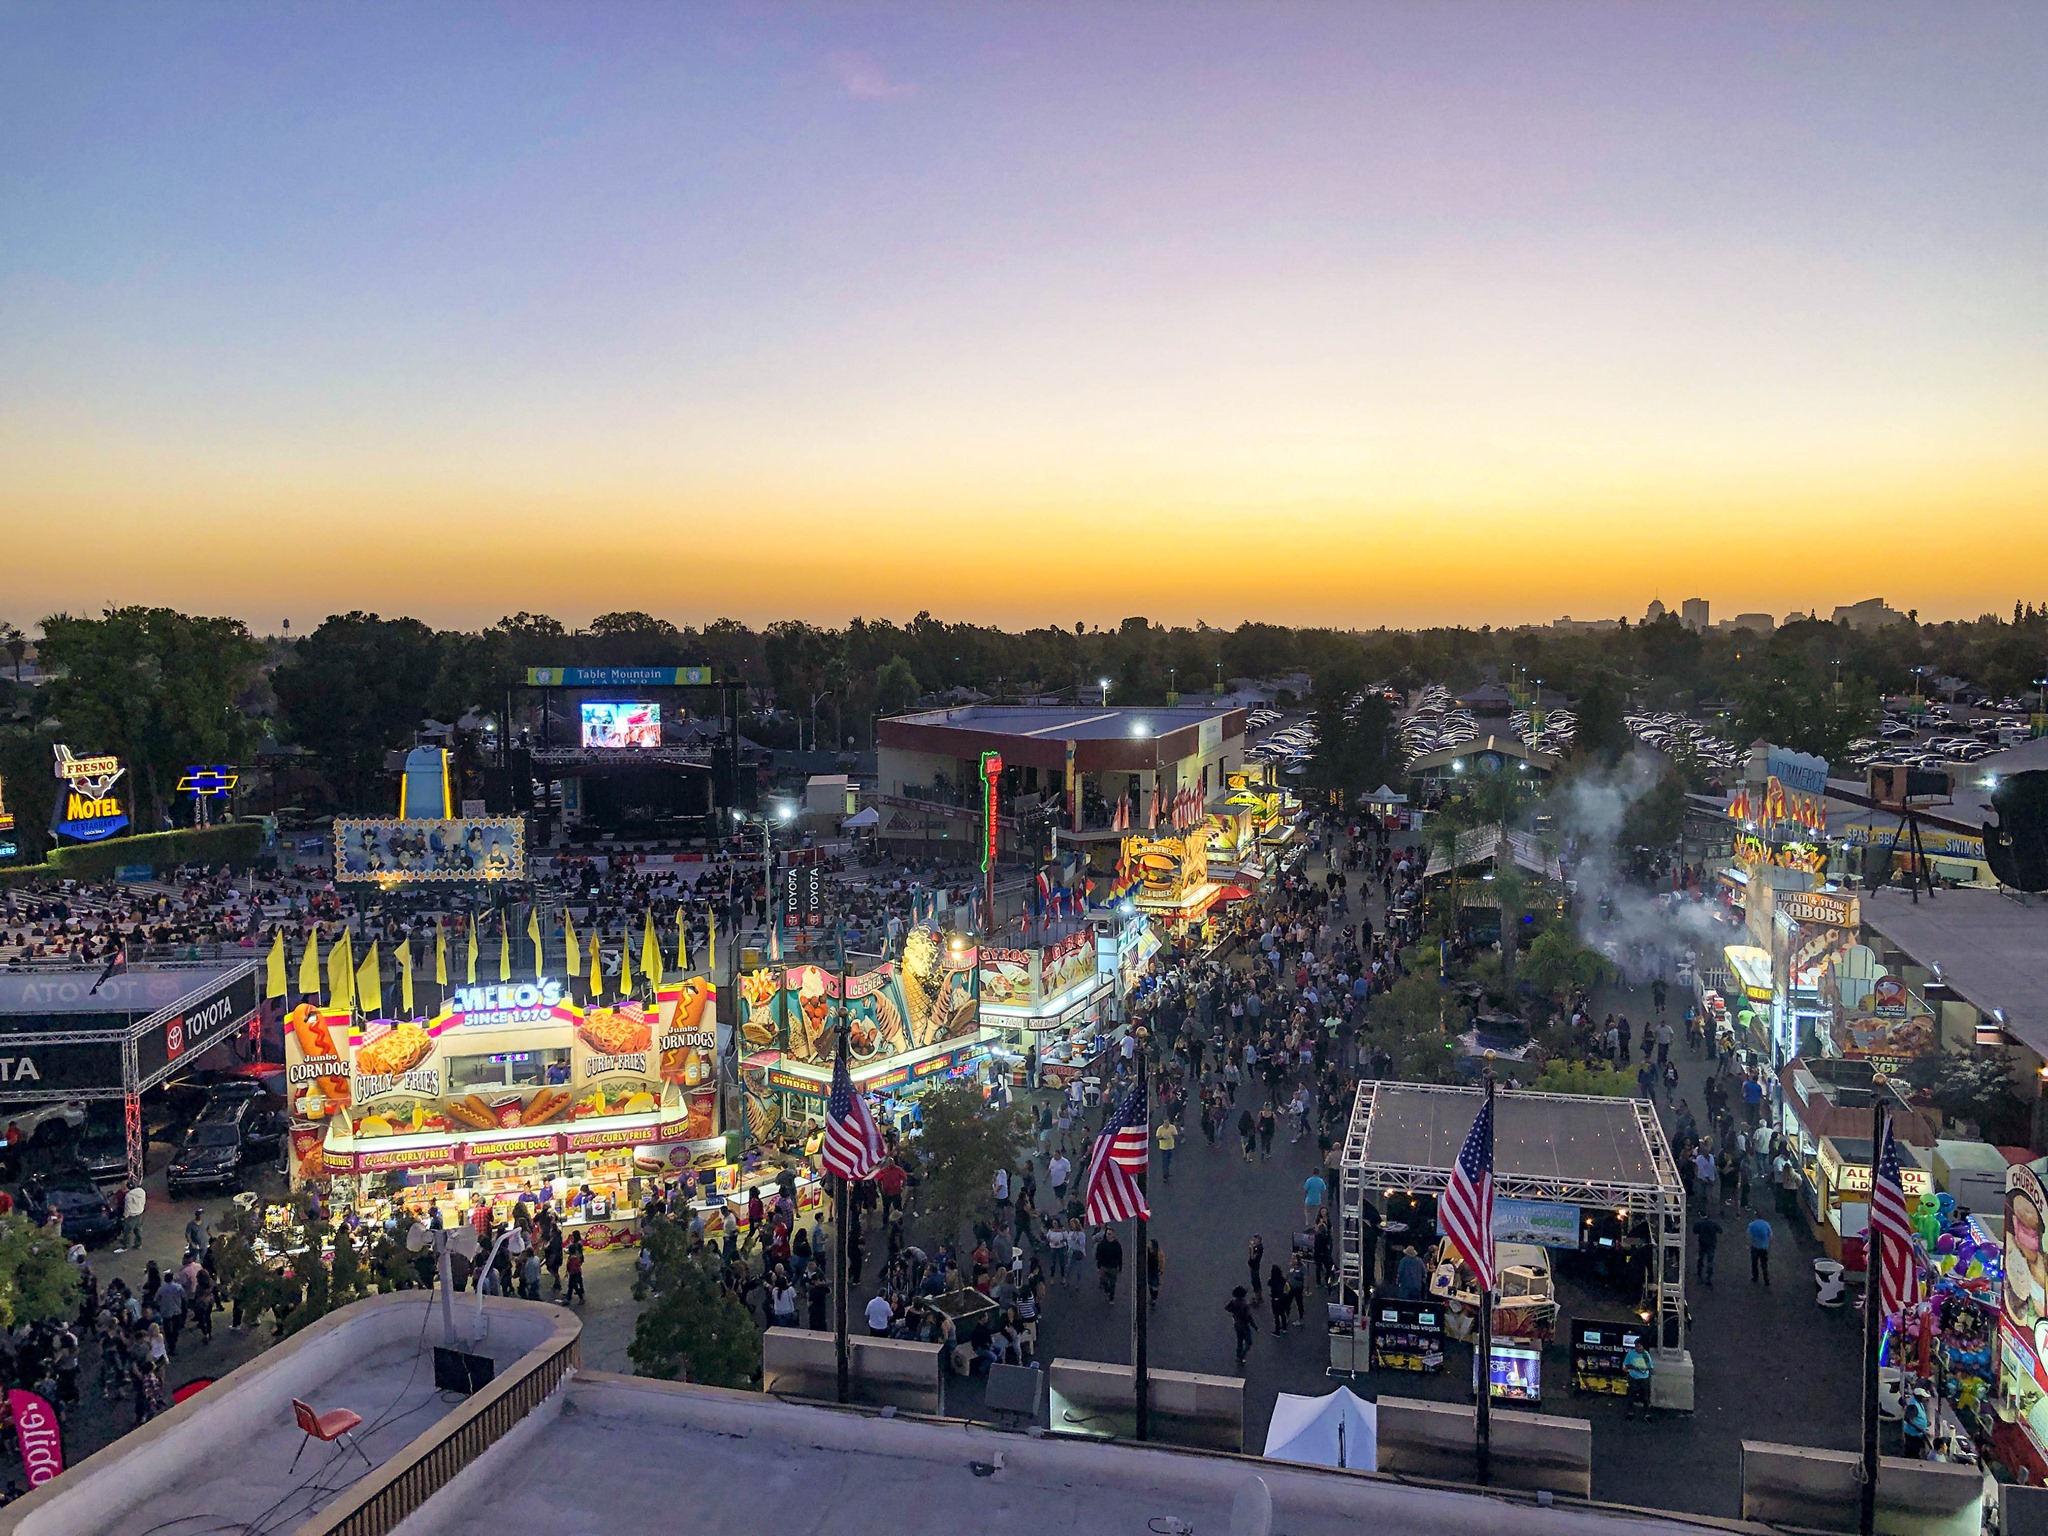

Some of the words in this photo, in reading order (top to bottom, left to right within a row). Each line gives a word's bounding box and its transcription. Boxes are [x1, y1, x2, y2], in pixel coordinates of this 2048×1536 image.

[577, 669, 606, 679] Table
[611, 669, 662, 679] Mountain
[67, 760, 115, 774] FRESNO
[1776, 761, 1827, 794] COMMERCE
[67, 793, 121, 821] MOTEL
[71, 819, 117, 832] RESTAURANT
[1846, 828, 1869, 843] SPAS
[1945, 838, 1973, 855] SWIM
[788, 868, 798, 912] TOYOTA
[809, 867, 819, 911] TOYOTA
[1777, 892, 1809, 904] CHICKEN
[1811, 895, 1818, 905] &
[1820, 897, 1846, 912] STEAK
[1777, 901, 1846, 924] KABOBS
[1052, 929, 1087, 962] GYRS
[979, 947, 1031, 965] GYROS
[850, 981, 863, 996] ICE
[863, 972, 887, 991] CREA
[185, 996, 233, 1040] TOYOTA
[464, 1011, 508, 1026] SINCE
[512, 1008, 552, 1022] 1970
[1029, 1019, 1044, 1028] Cold
[668, 1026, 699, 1034] Jumbo
[659, 1034, 686, 1054] CORN
[686, 1030, 716, 1049] DOGS
[304, 1053, 338, 1063] Jumbo
[585, 1054, 616, 1078] CURLY
[618, 1052, 646, 1074] FRIES
[290, 1062, 325, 1084] CORN
[325, 1060, 350, 1077] DOG
[355, 1072, 394, 1103] CURLY
[404, 1069, 440, 1096] FRIES
[773, 1076, 819, 1093] SUNDAES
[573, 1134, 601, 1147] Giant
[601, 1133, 628, 1144] CURLY
[629, 1130, 652, 1141] FRIES
[663, 1126, 678, 1137] COLD
[472, 1144, 502, 1155] JUMBO
[503, 1142, 526, 1153] CORN
[527, 1138, 551, 1149] DOGS
[329, 1156, 352, 1166] DRINKS
[365, 1153, 395, 1167] Giant
[395, 1151, 423, 1163] CURLY
[425, 1149, 449, 1160] FRIES
[1846, 1168, 1926, 1183] ALOL
[2011, 1172, 2044, 1213] CHURROS
[1505, 1214, 1528, 1224] WIN
[1375, 1321, 1410, 1331] experience
[1410, 1323, 1420, 1331] las
[1420, 1325, 1441, 1333] vegas
[1575, 1342, 1613, 1351] experience
[1490, 1362, 1512, 1374] gas
